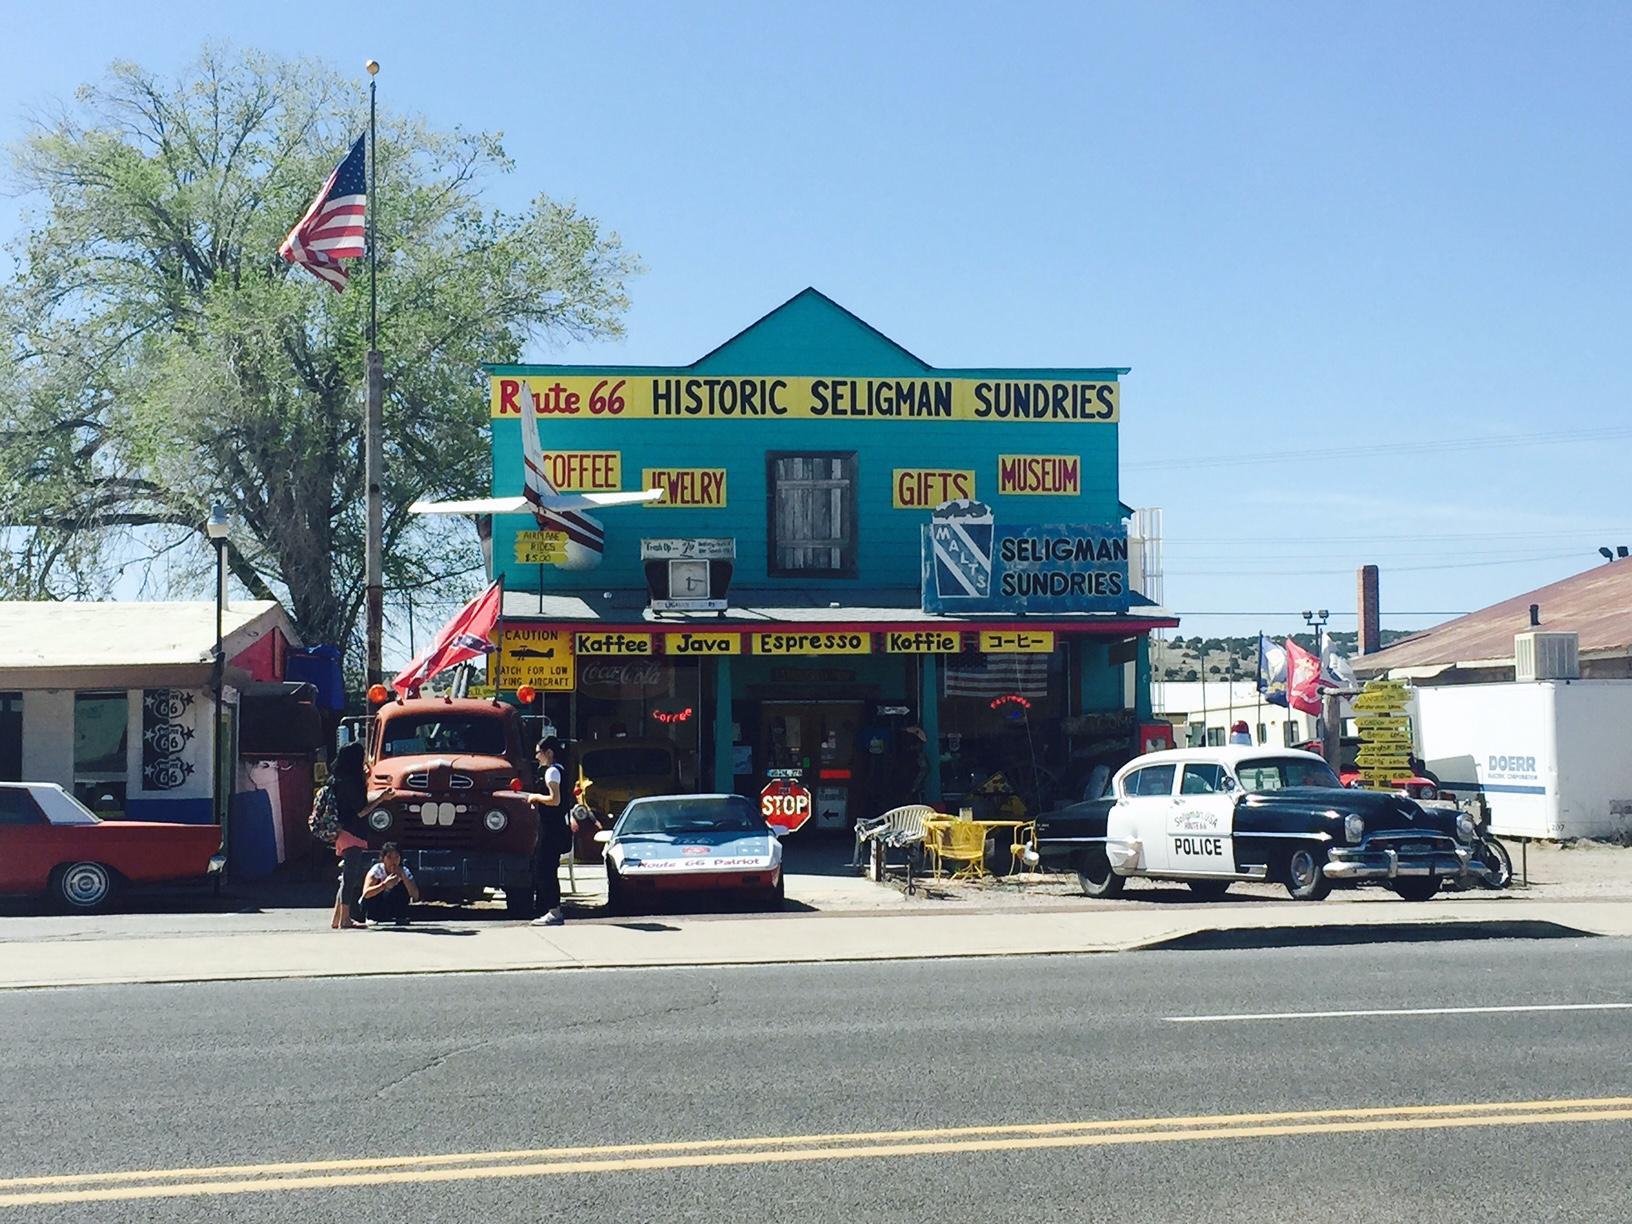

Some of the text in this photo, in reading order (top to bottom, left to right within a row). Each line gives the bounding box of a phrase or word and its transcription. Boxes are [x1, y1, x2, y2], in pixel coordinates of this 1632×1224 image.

[499, 379, 1115, 419] Rute 66 HISTORIC SELIGMAN SUNDRIES
[543, 454, 617, 489] OFFEE
[1001, 458, 1079, 492] MUSEUM
[899, 472, 969, 506] GIFTS
[936, 527, 987, 588] MALTS
[1001, 537, 1128, 562] SELIGMAN
[1002, 571, 1123, 597] SUNDRIES
[505, 630, 559, 641] CAUTION
[578, 634, 648, 653] Kaffee
[676, 633, 731, 652] Java
[760, 633, 862, 654] Espresso
[890, 633, 955, 652] Koffie
[988, 634, 1044, 648] コーヒー
[527, 666, 545, 675] FOR
[550, 666, 568, 675] LOW
[528, 678, 569, 687] AIRCRAFT
[160, 701, 178, 714] 66
[160, 736, 179, 749] 66
[1488, 755, 1536, 772] DOERR
[160, 770, 178, 783] 66
[762, 794, 808, 817] STOP
[1174, 838, 1223, 856] POLICE
[714, 857, 760, 866] Patriot
